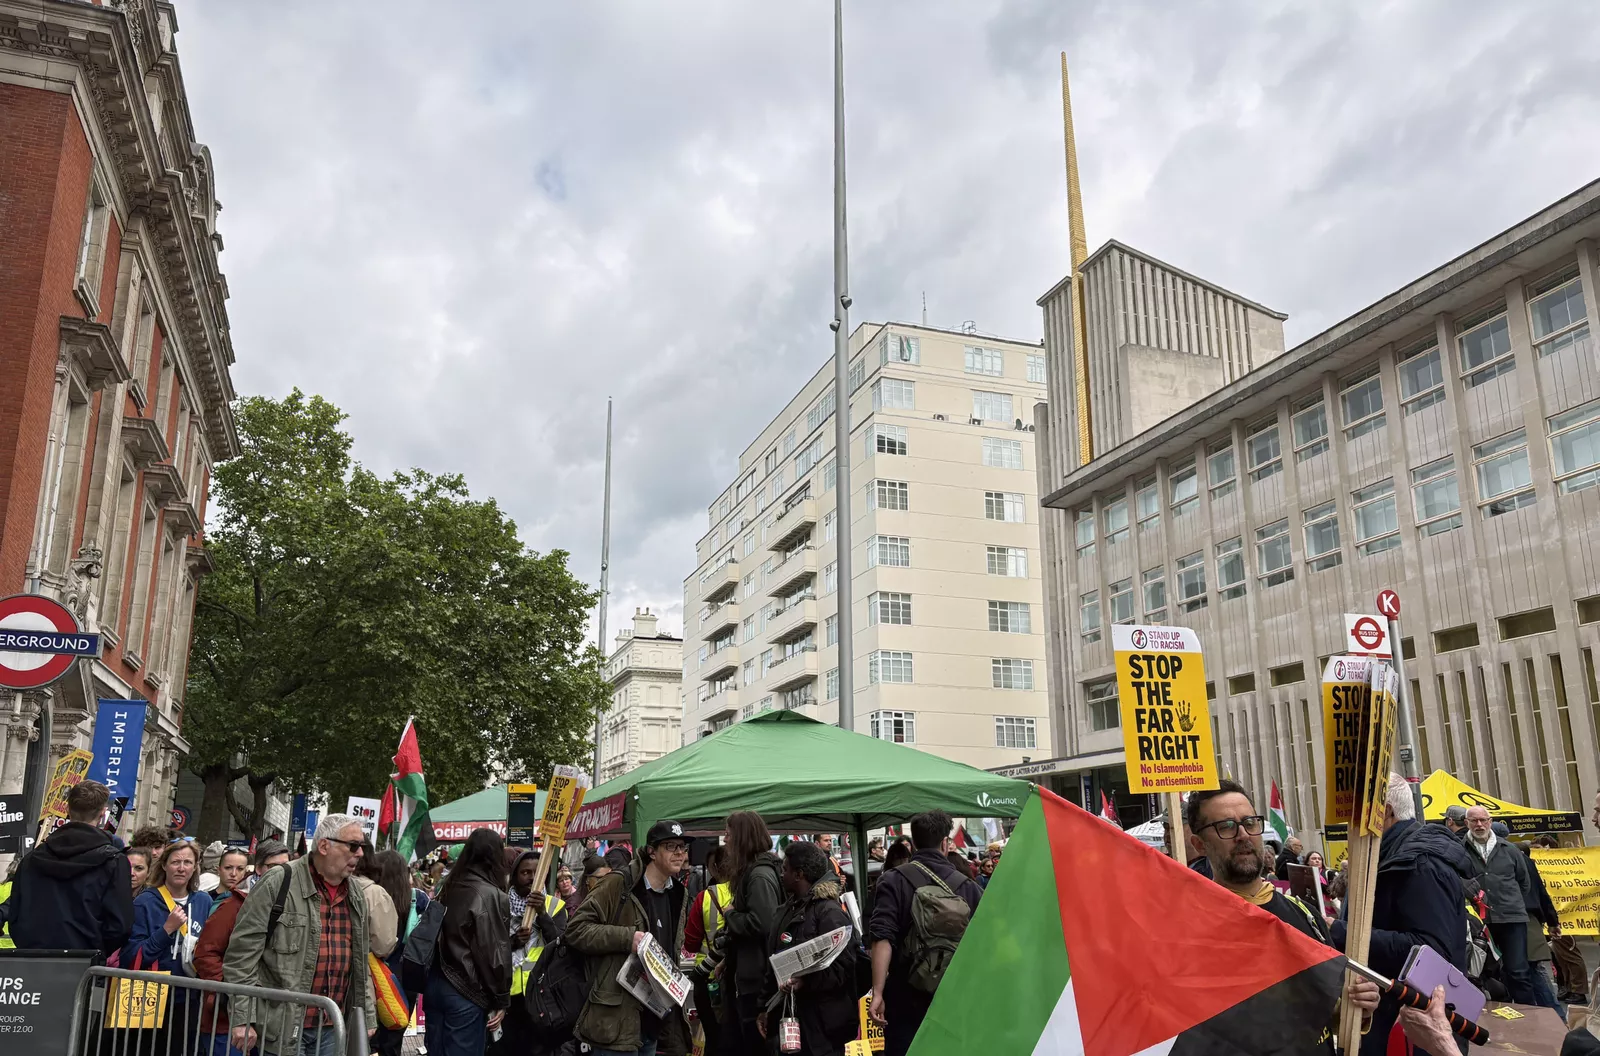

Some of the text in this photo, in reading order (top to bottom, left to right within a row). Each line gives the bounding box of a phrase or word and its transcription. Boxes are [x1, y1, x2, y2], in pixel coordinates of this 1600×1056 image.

[1382, 593, 1398, 613] K
[1148, 631, 1181, 641] STAND UP
[1150, 641, 1185, 650] TO RACISM
[1128, 654, 1183, 680] STOP
[1131, 681, 1173, 706] THE
[1135, 708, 1175, 733] FAR
[1138, 735, 1200, 761] RIGHT
[1140, 762, 1204, 775] No Islamophobia
[554, 777, 570, 788] STOP
[1142, 776, 1205, 787] No antisemitism
[552, 788, 562, 799] THE
[548, 799, 558, 810] FAR
[545, 810, 564, 823] RIGHT
[1550, 881, 1562, 889] up
[1562, 880, 1574, 888] to
[1576, 918, 1598, 929] Matt
[12, 1025, 33, 1033] 12.00
